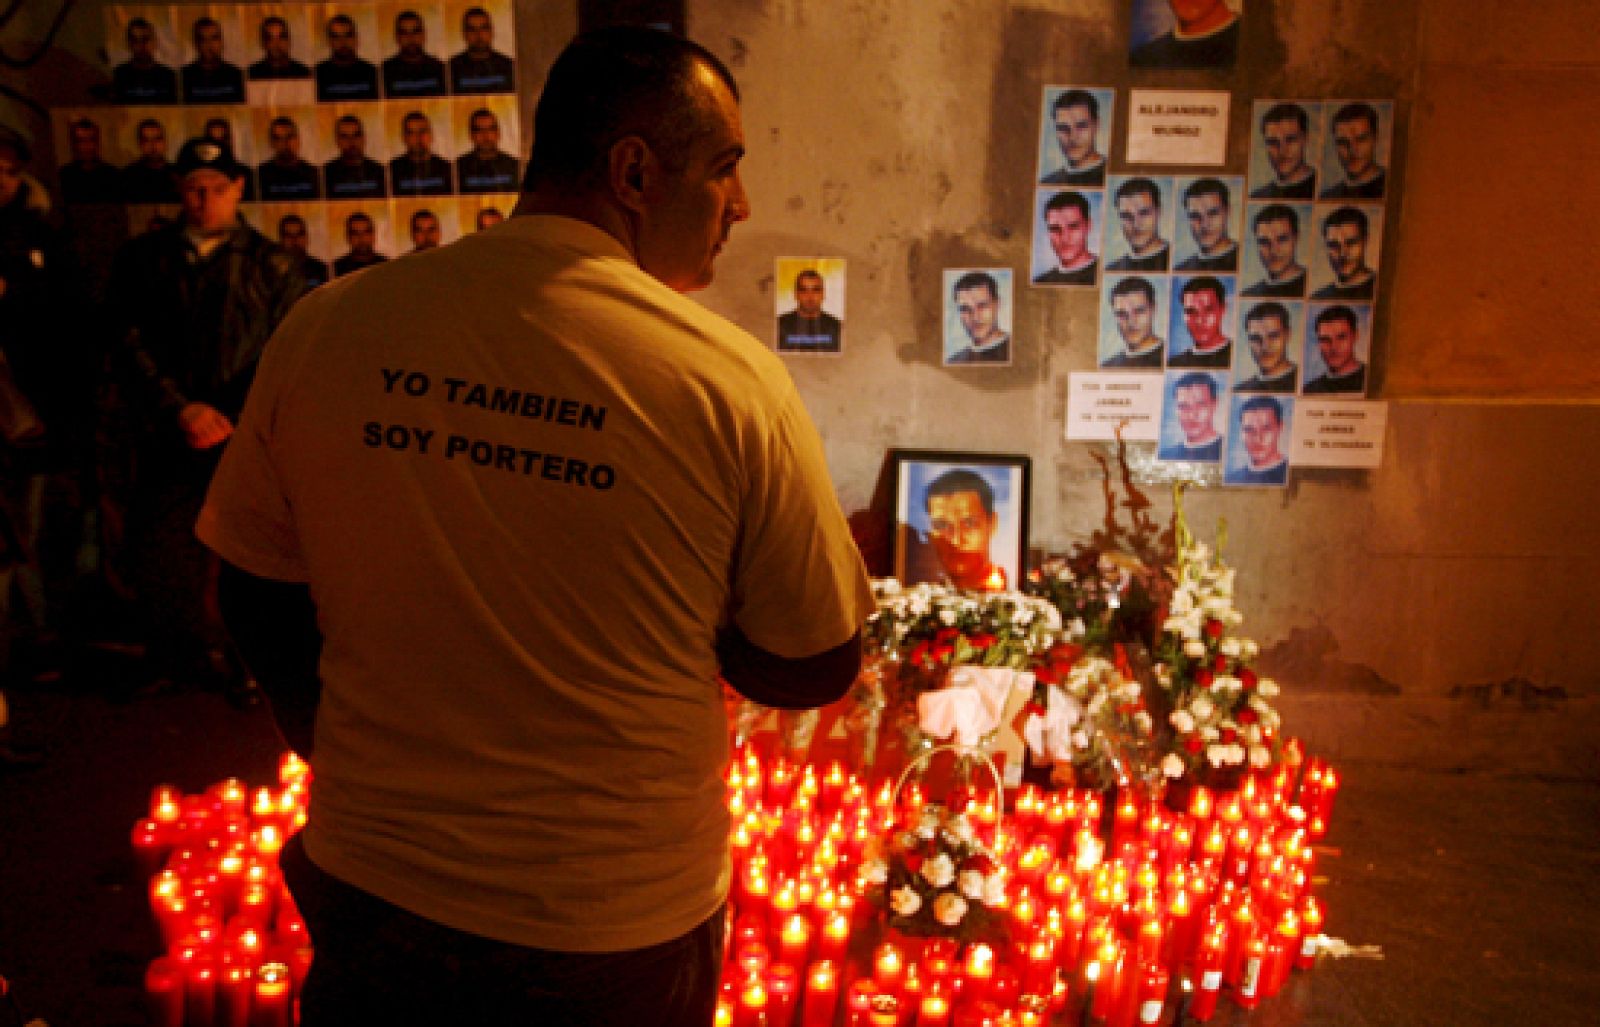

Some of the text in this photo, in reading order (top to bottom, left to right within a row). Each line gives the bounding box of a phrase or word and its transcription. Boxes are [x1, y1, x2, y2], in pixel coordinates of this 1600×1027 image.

[380, 368, 608, 432] YO TAMBIEN
[362, 421, 616, 490] SOY PORTERO
